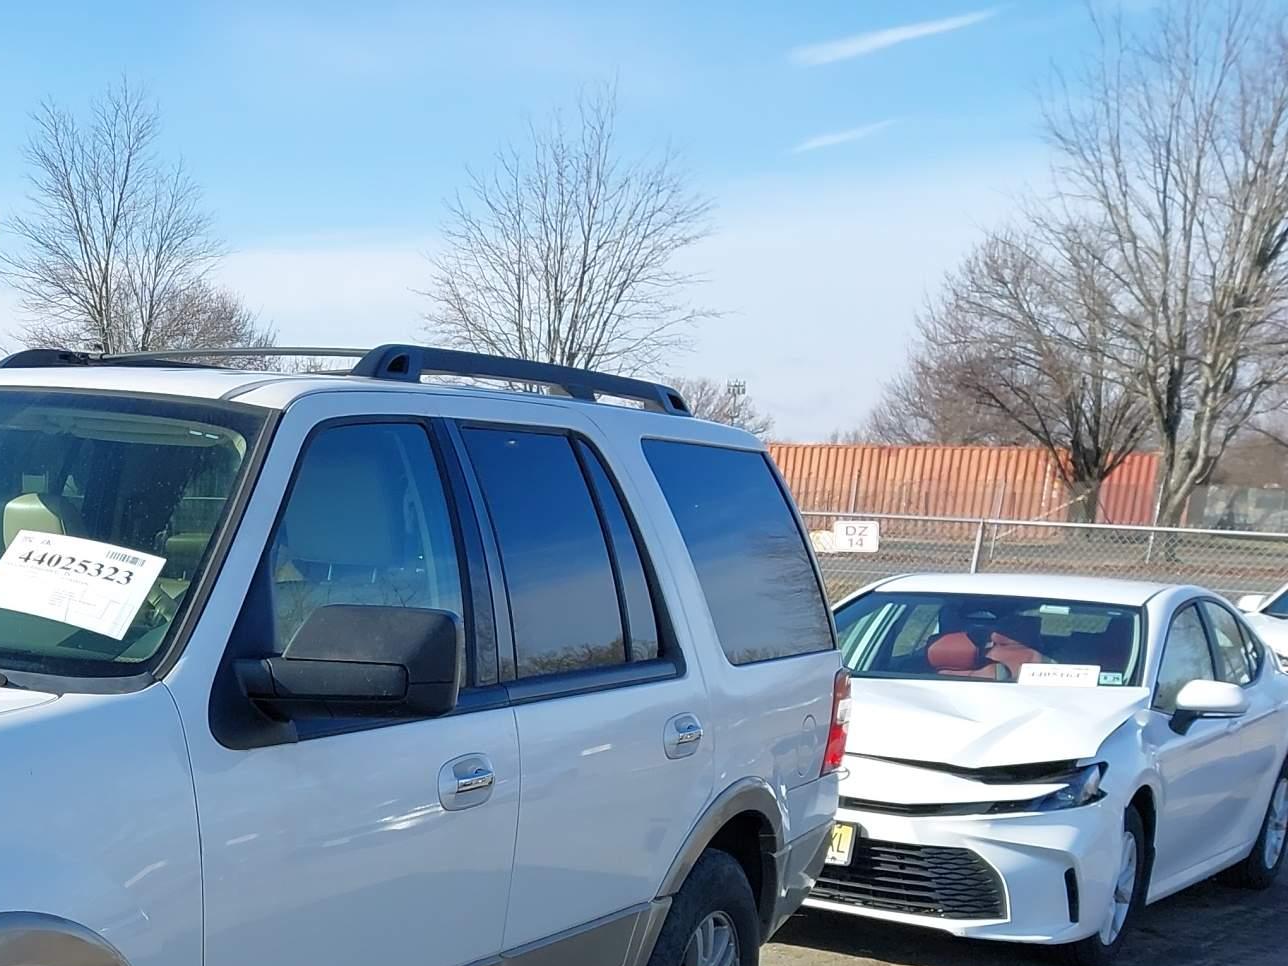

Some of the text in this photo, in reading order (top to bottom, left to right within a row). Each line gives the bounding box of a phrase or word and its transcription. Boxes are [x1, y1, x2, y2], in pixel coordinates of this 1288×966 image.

[845, 525, 869, 537] DZ
[848, 538, 864, 547] 14
[18, 549, 134, 586] 44025323
